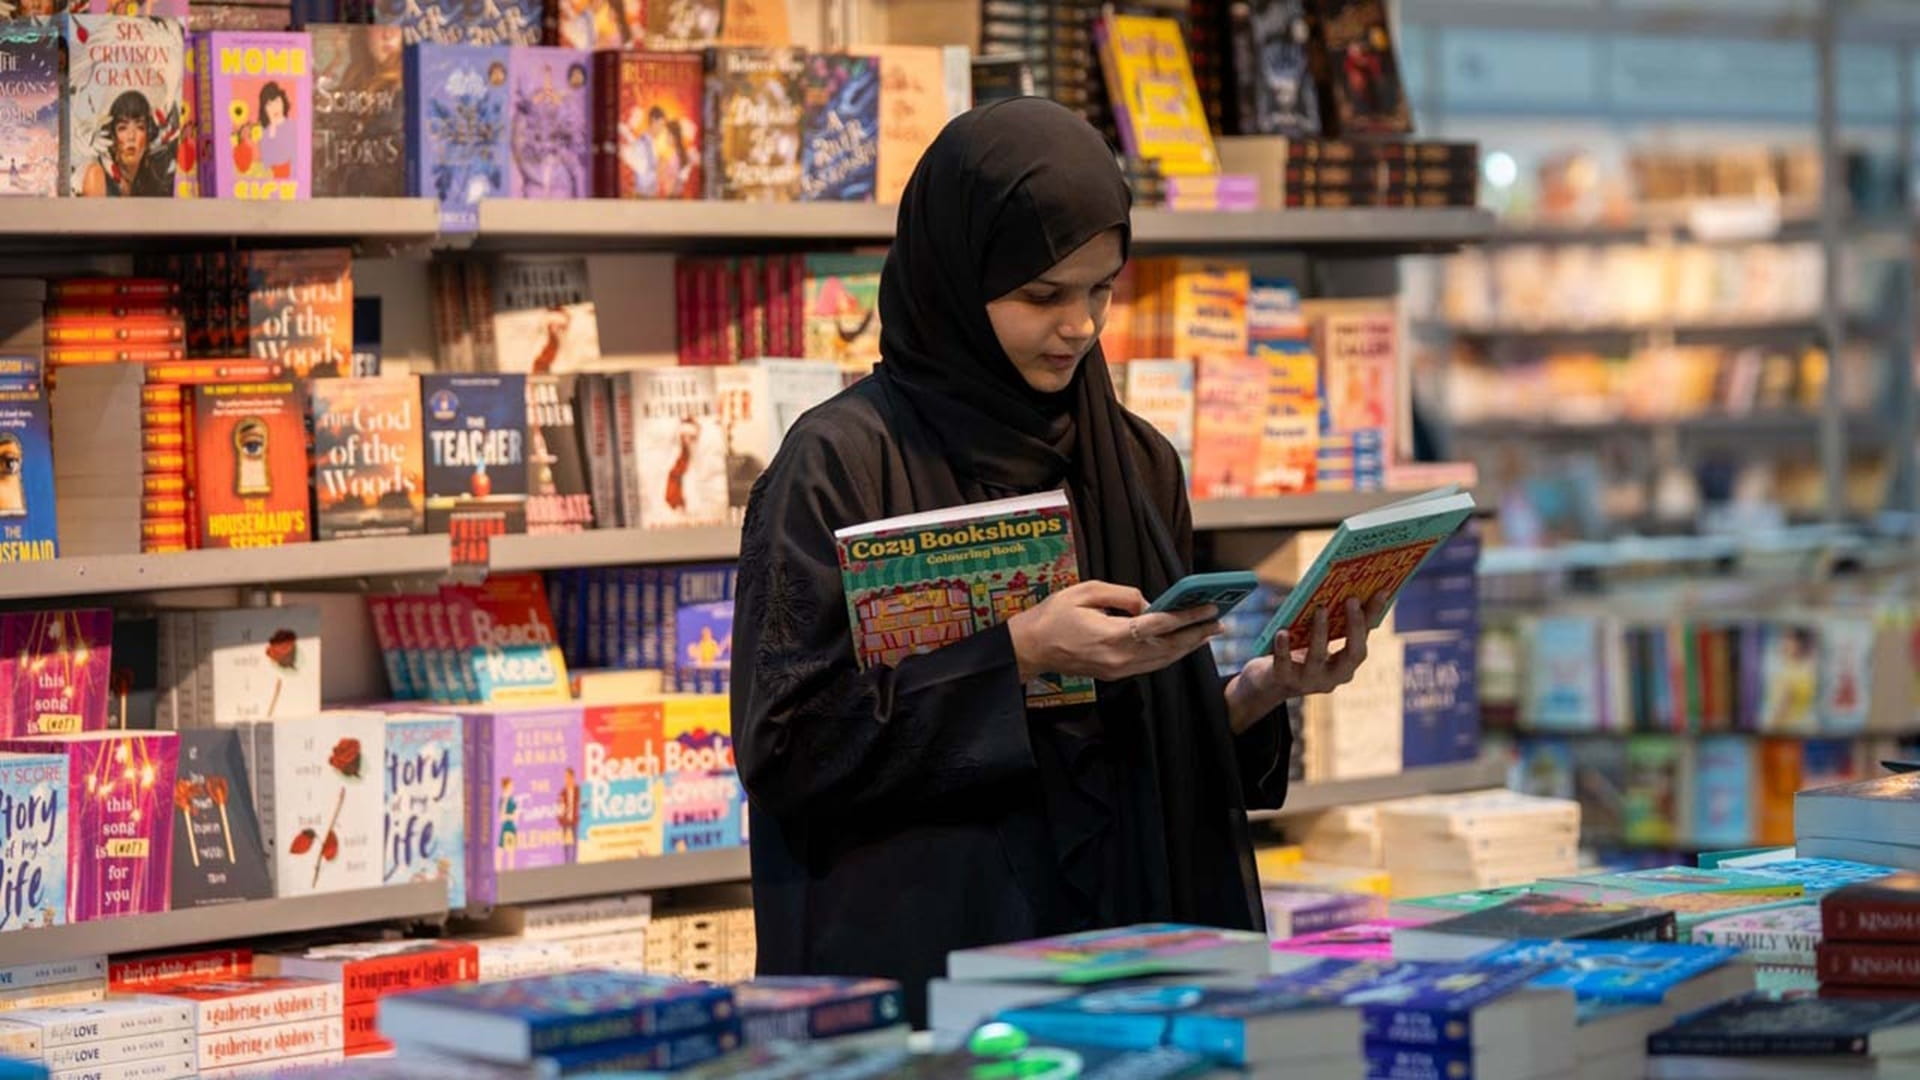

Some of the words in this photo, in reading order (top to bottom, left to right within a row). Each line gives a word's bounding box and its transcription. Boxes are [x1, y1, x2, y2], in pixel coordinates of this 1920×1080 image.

[117, 23, 144, 41] SIX
[89, 46, 168, 63] CRIMSON
[220, 48, 305, 75] HOME
[95, 68, 166, 86] CRANES
[288, 277, 342, 303] God
[263, 305, 294, 337] of
[297, 305, 336, 337] the
[257, 337, 343, 368] Woods
[353, 400, 411, 431] God
[466, 417, 485, 428] THE
[329, 434, 361, 466] of
[363, 433, 405, 465] the
[430, 430, 522, 467] TEACHER
[323, 465, 416, 497] Woods
[5, 526, 22, 539] THE
[209, 510, 305, 536] HOUSEMAID'S
[852, 538, 917, 560] Cozy
[919, 517, 1061, 549] Bookshops
[0, 539, 55, 561] SEMAID
[926, 550, 992, 566] Colouring
[993, 543, 1026, 556] Book
[472, 609, 550, 646] Beach
[486, 645, 557, 684] Read
[39, 674, 65, 688] this
[35, 698, 68, 714] song
[27, 721, 38, 734] is
[514, 728, 564, 748] ELENA
[585, 739, 661, 781] Beach
[664, 737, 735, 770] Book
[15, 767, 62, 783] SCORE
[385, 748, 449, 802] tory
[106, 798, 133, 813] this
[592, 777, 656, 820] Read
[0, 788, 58, 847] tory
[103, 820, 136, 837] song
[96, 845, 107, 860] is
[108, 864, 129, 880] for
[105, 889, 131, 906] you
[1725, 931, 1778, 951] EMILY
[74, 1024, 98, 1038] LOVE
[75, 1048, 99, 1063] LOVE
